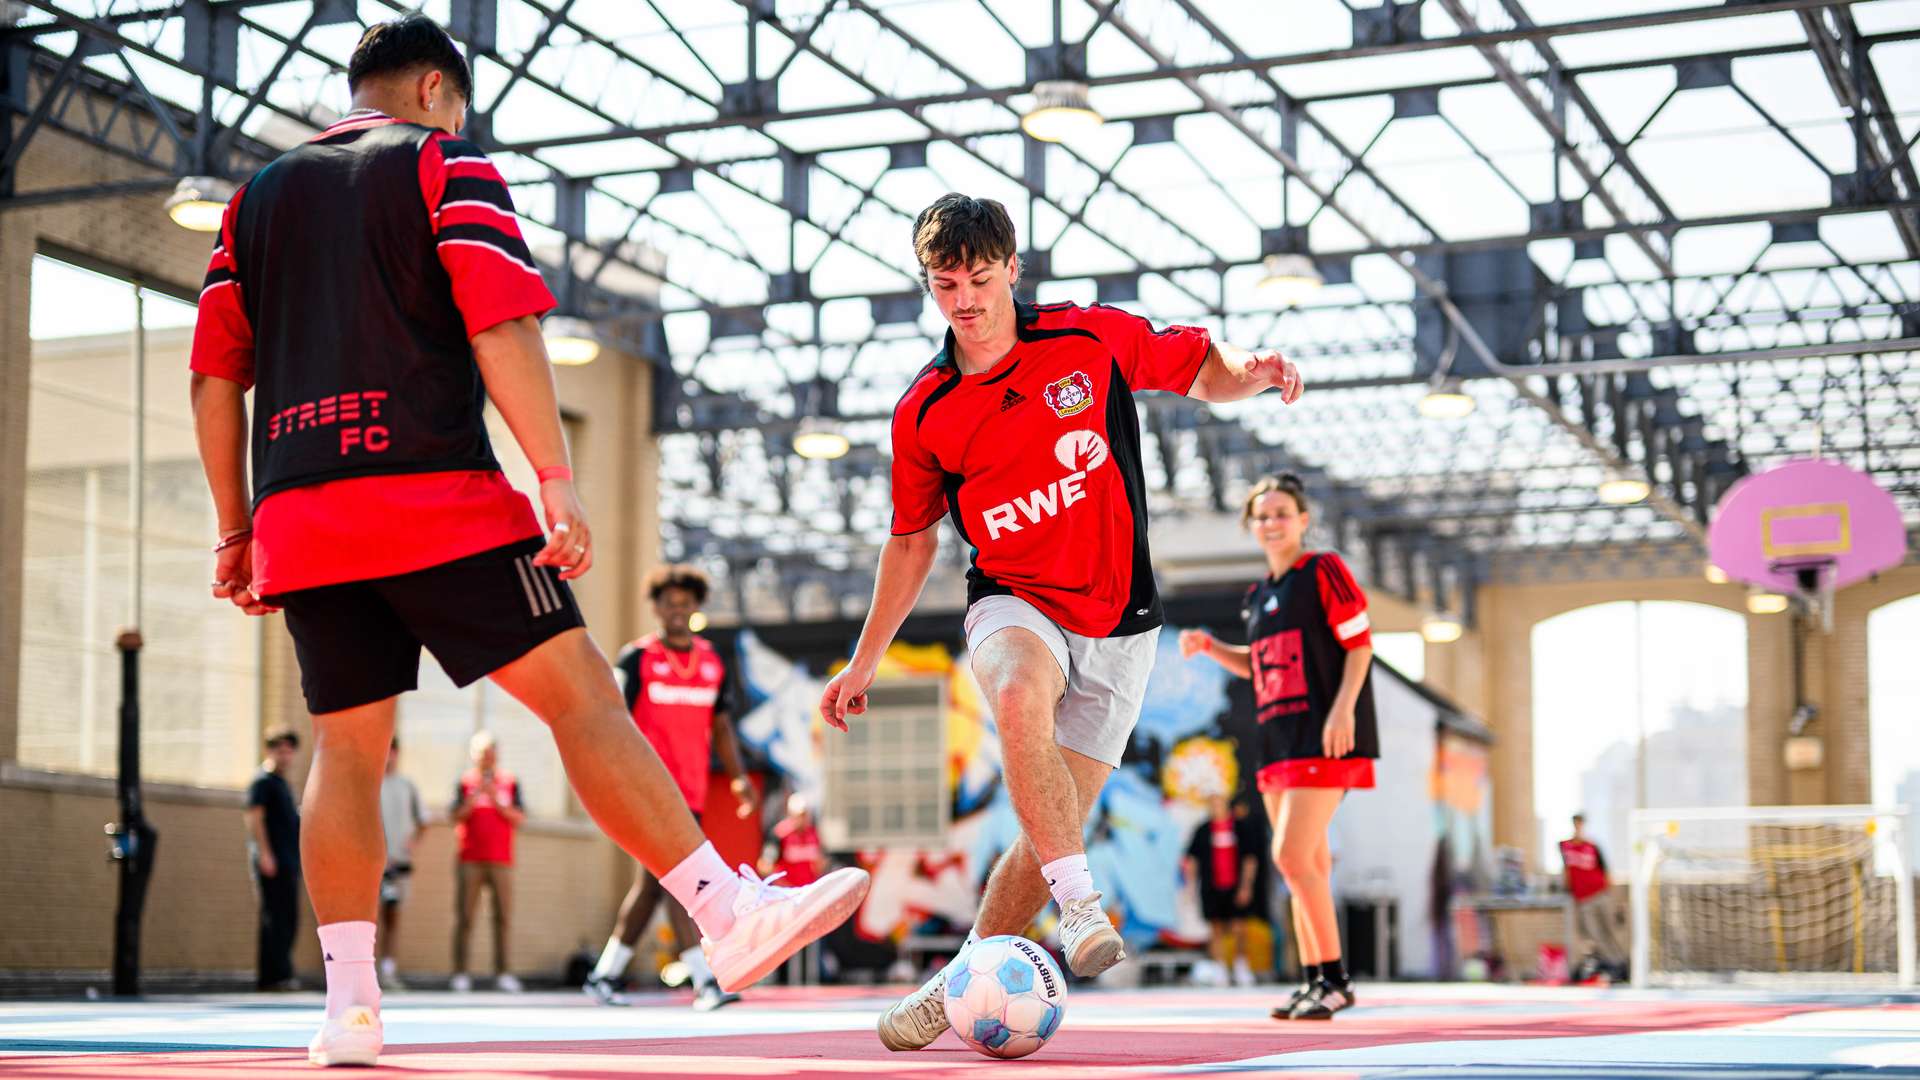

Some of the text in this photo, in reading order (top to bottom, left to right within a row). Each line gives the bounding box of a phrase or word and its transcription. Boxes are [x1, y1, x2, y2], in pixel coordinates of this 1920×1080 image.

[268, 390, 388, 441] STREET
[1000, 395, 1027, 412] adidas
[1061, 390, 1080, 402] BAYER
[340, 425, 389, 455] FC
[982, 470, 1087, 540] RWE
[1014, 941, 1057, 998] DERBYSTAR
